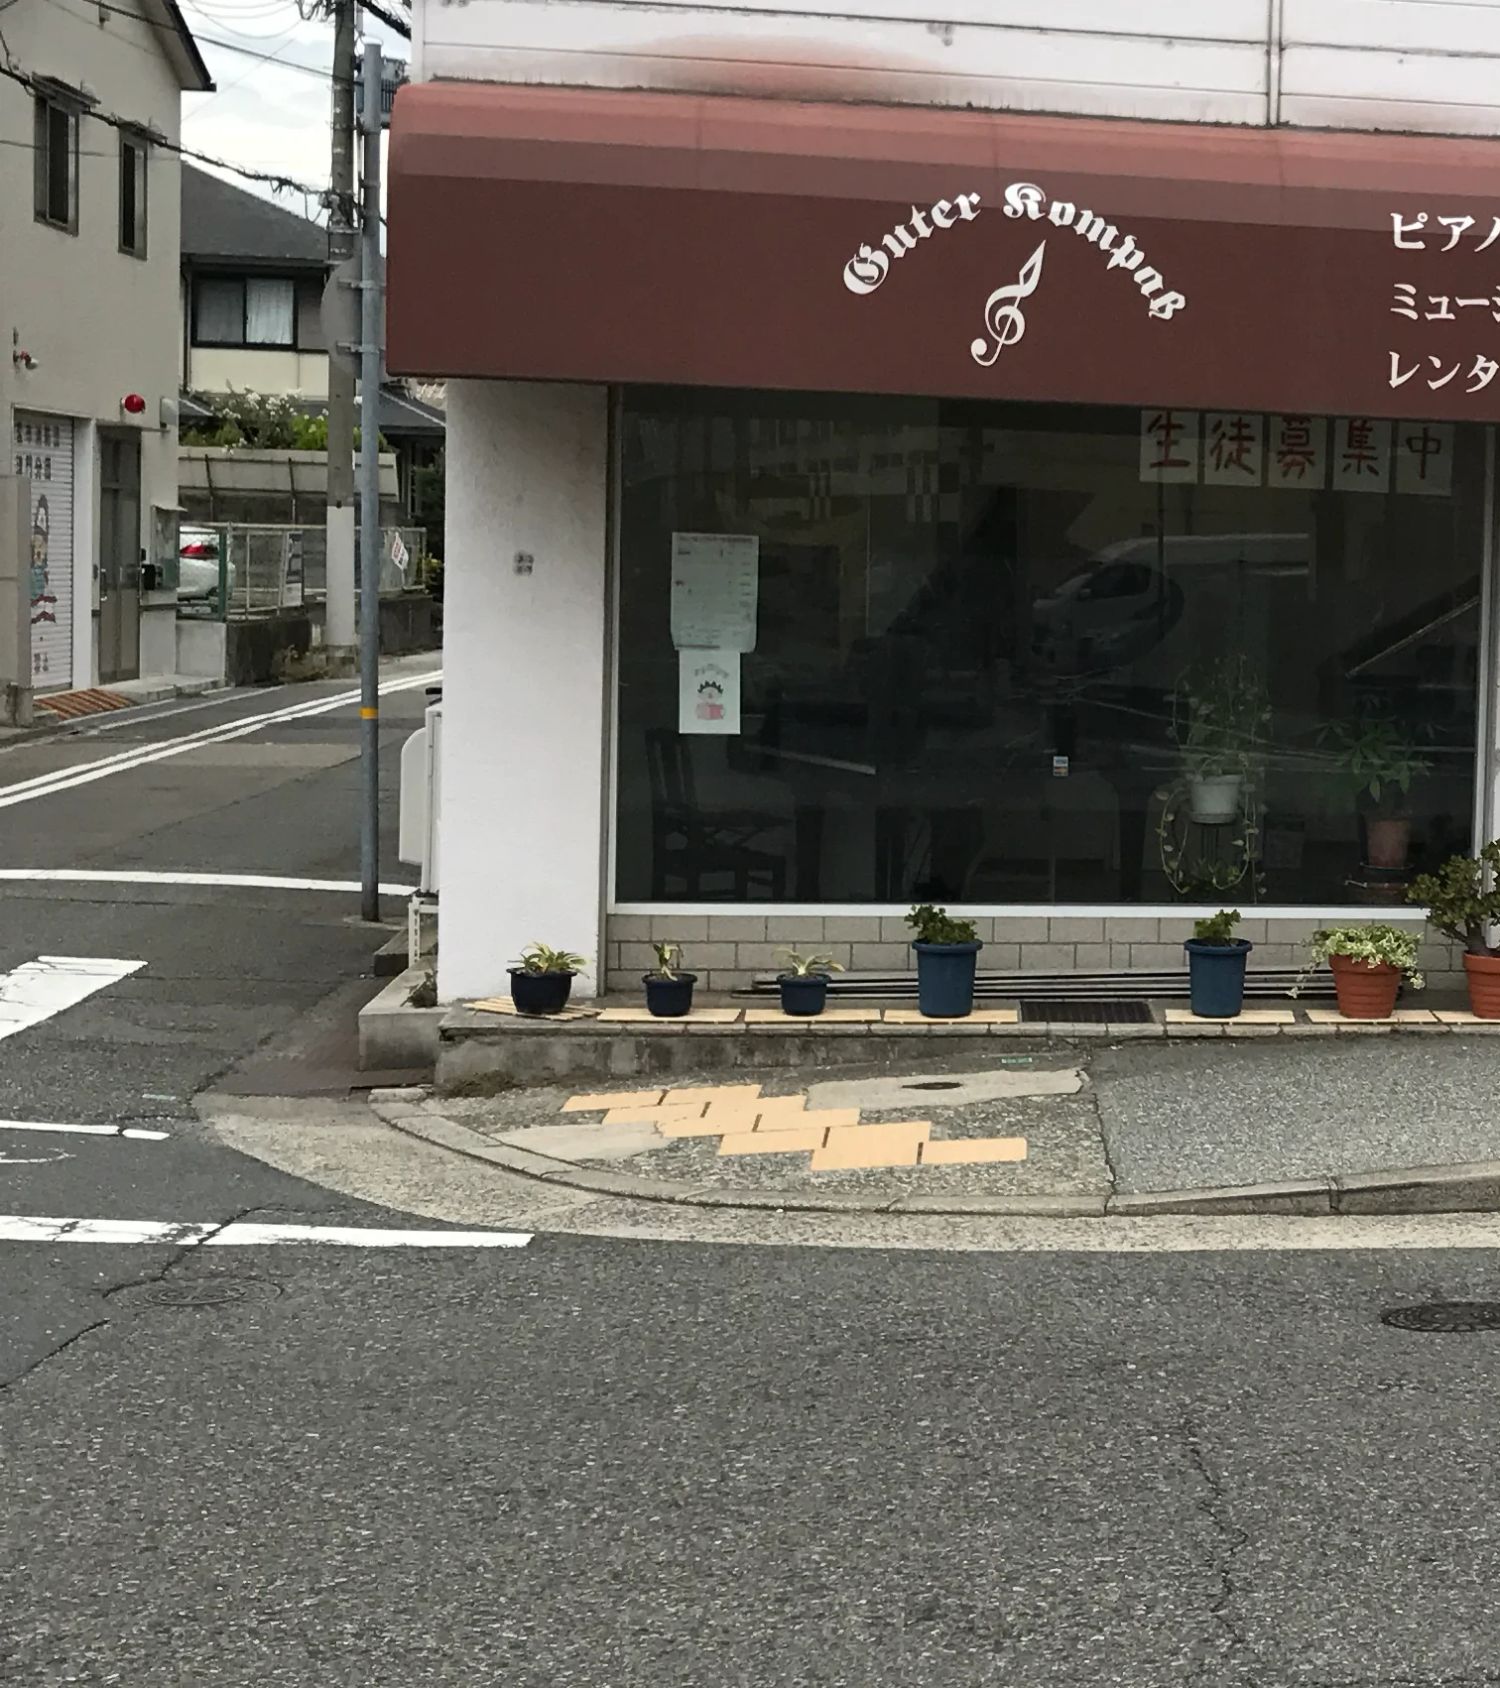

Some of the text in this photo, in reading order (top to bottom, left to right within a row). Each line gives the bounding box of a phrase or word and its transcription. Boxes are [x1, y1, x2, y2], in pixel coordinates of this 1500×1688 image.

[843, 192, 982, 295] Guter
[1146, 411, 1442, 480] 生徒募集中
